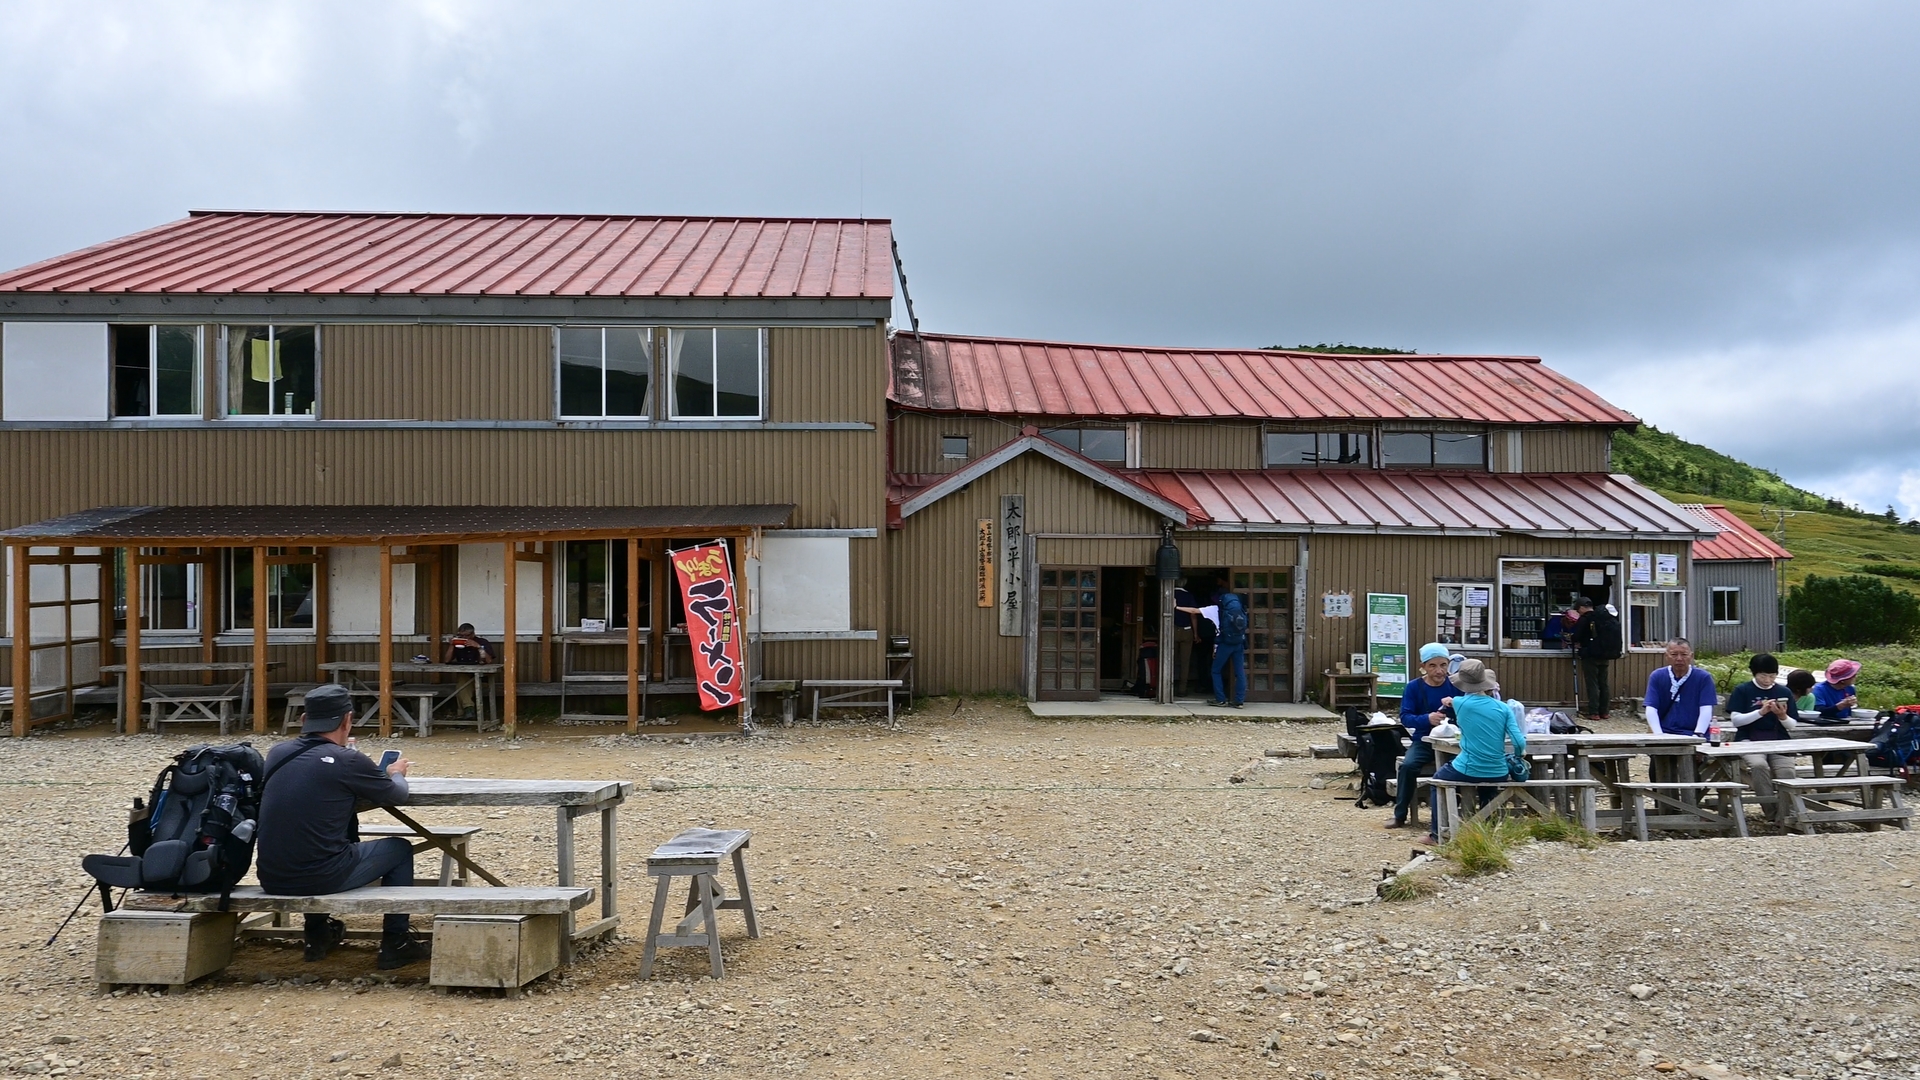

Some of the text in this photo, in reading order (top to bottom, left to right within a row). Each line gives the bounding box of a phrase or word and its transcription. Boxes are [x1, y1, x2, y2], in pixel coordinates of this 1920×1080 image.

[1003, 501, 1021, 611] 太郎平小屋
